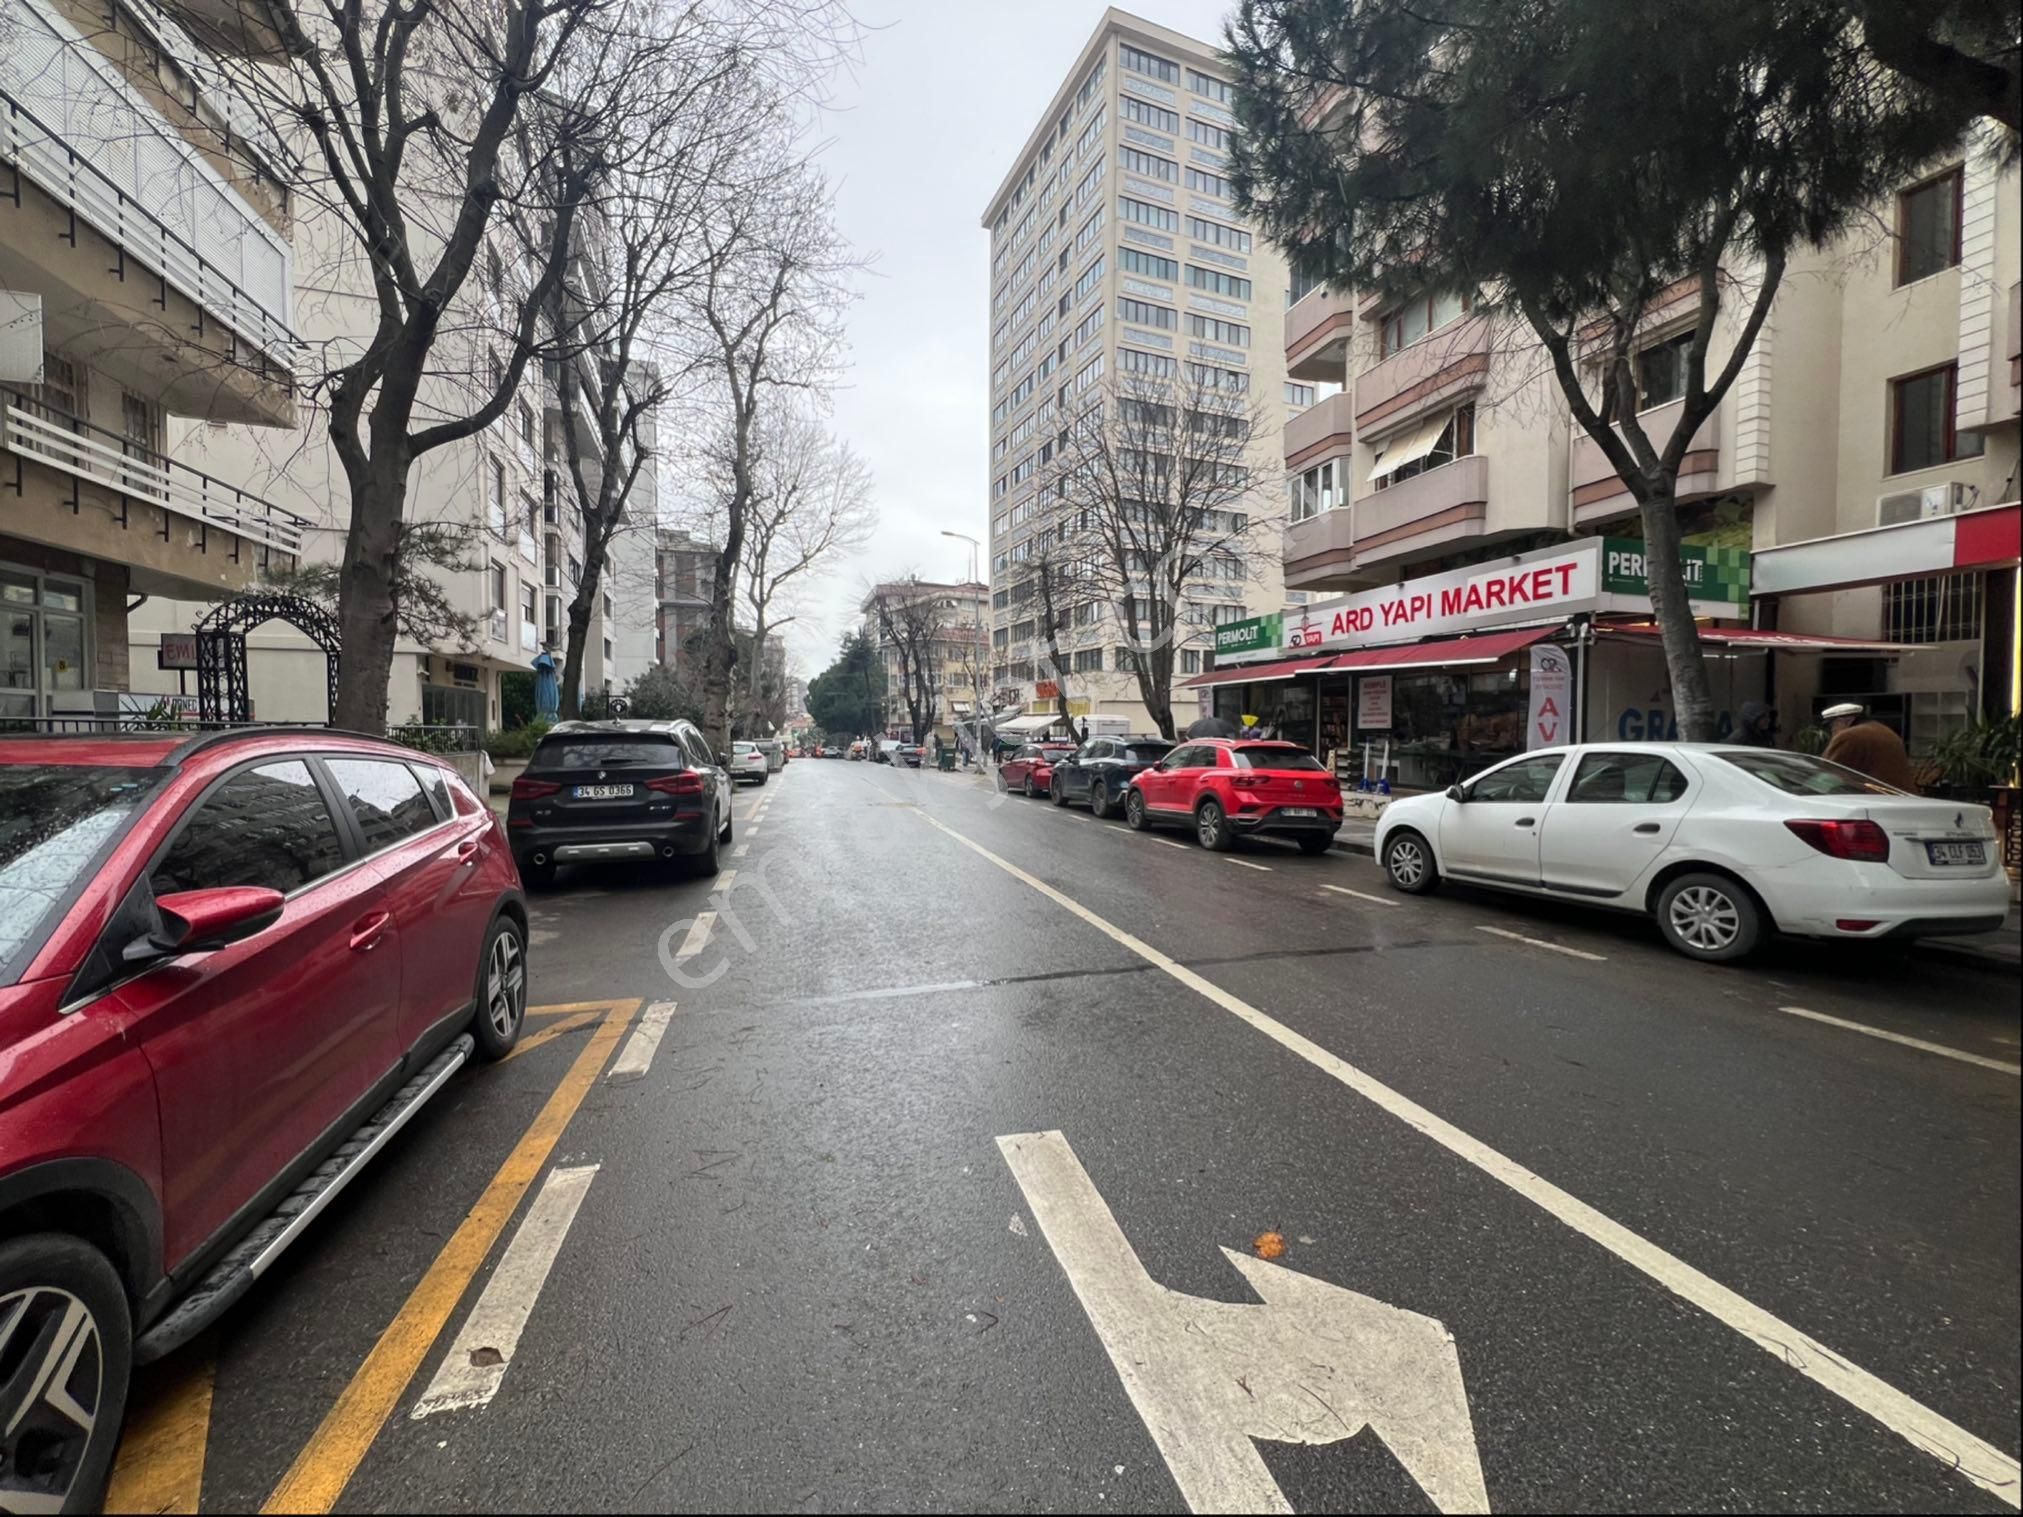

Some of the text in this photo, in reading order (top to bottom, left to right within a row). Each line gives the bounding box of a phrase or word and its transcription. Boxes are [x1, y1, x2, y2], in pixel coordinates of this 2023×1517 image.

[1608, 551, 1703, 582] PERIT
[1331, 562, 1578, 635] ARD YAPI MARKET
[1218, 625, 1259, 645] PERMOLIT
[578, 787, 590, 796] 34
